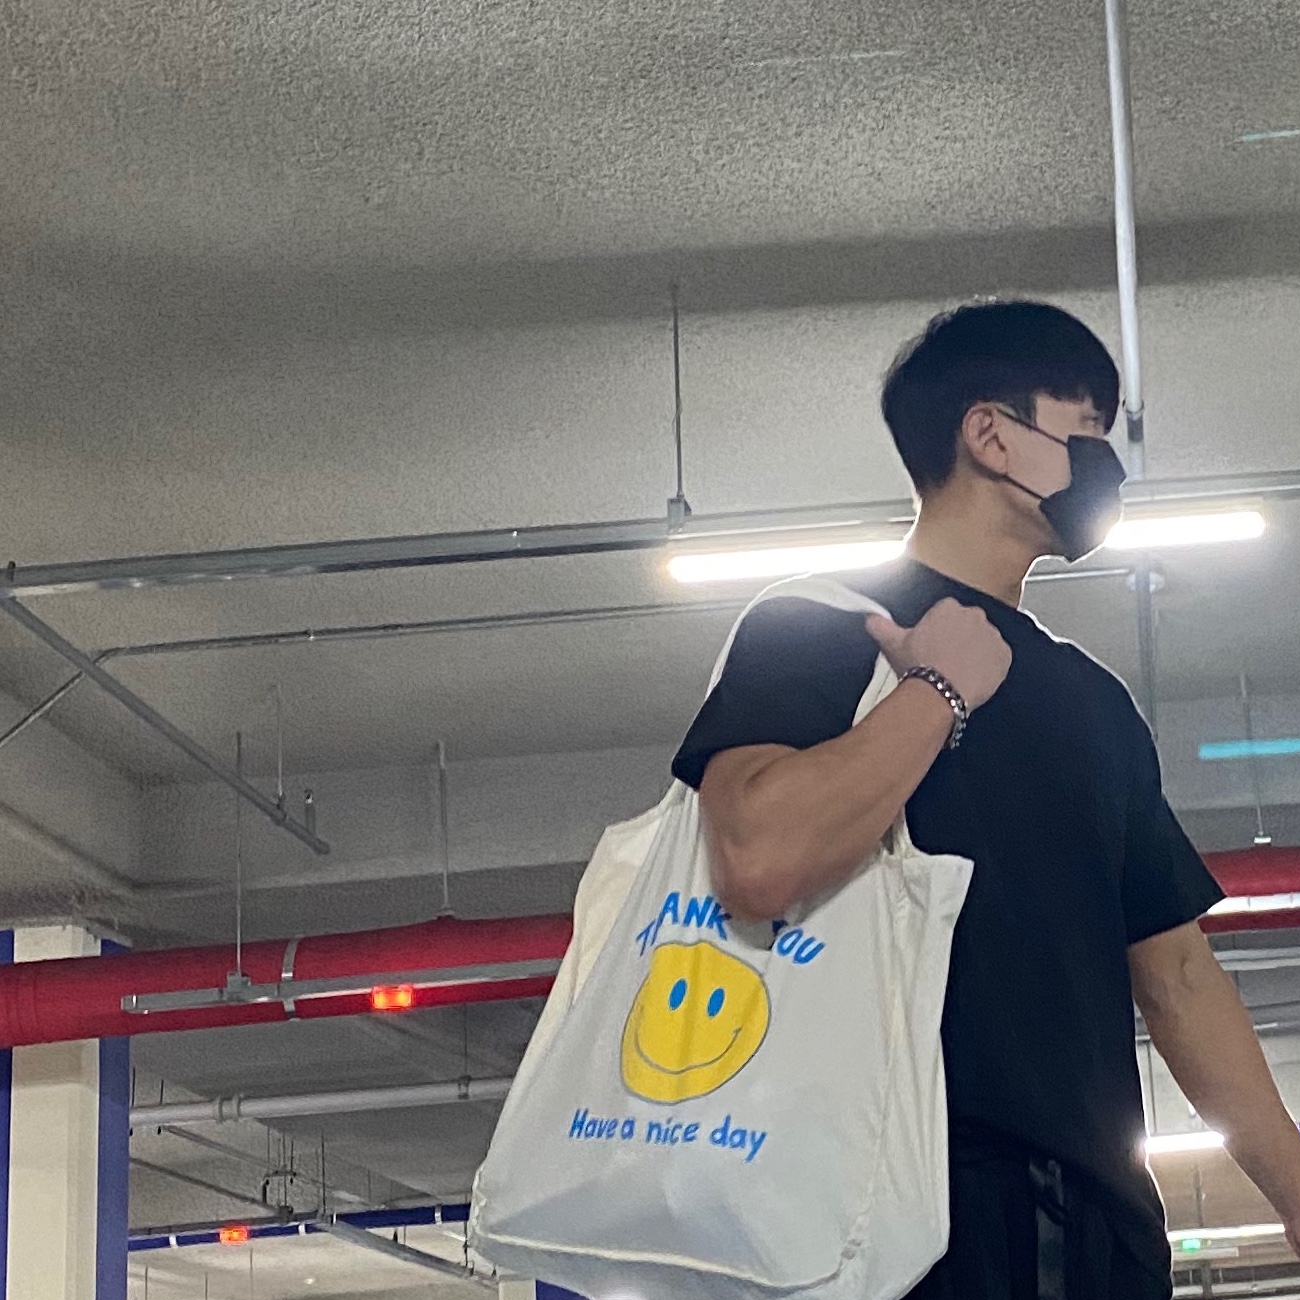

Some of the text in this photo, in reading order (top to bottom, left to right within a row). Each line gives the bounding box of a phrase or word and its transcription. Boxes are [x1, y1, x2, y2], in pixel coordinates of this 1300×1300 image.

[636, 891, 732, 957] TANK
[568, 1108, 767, 1164] Have a nice day
